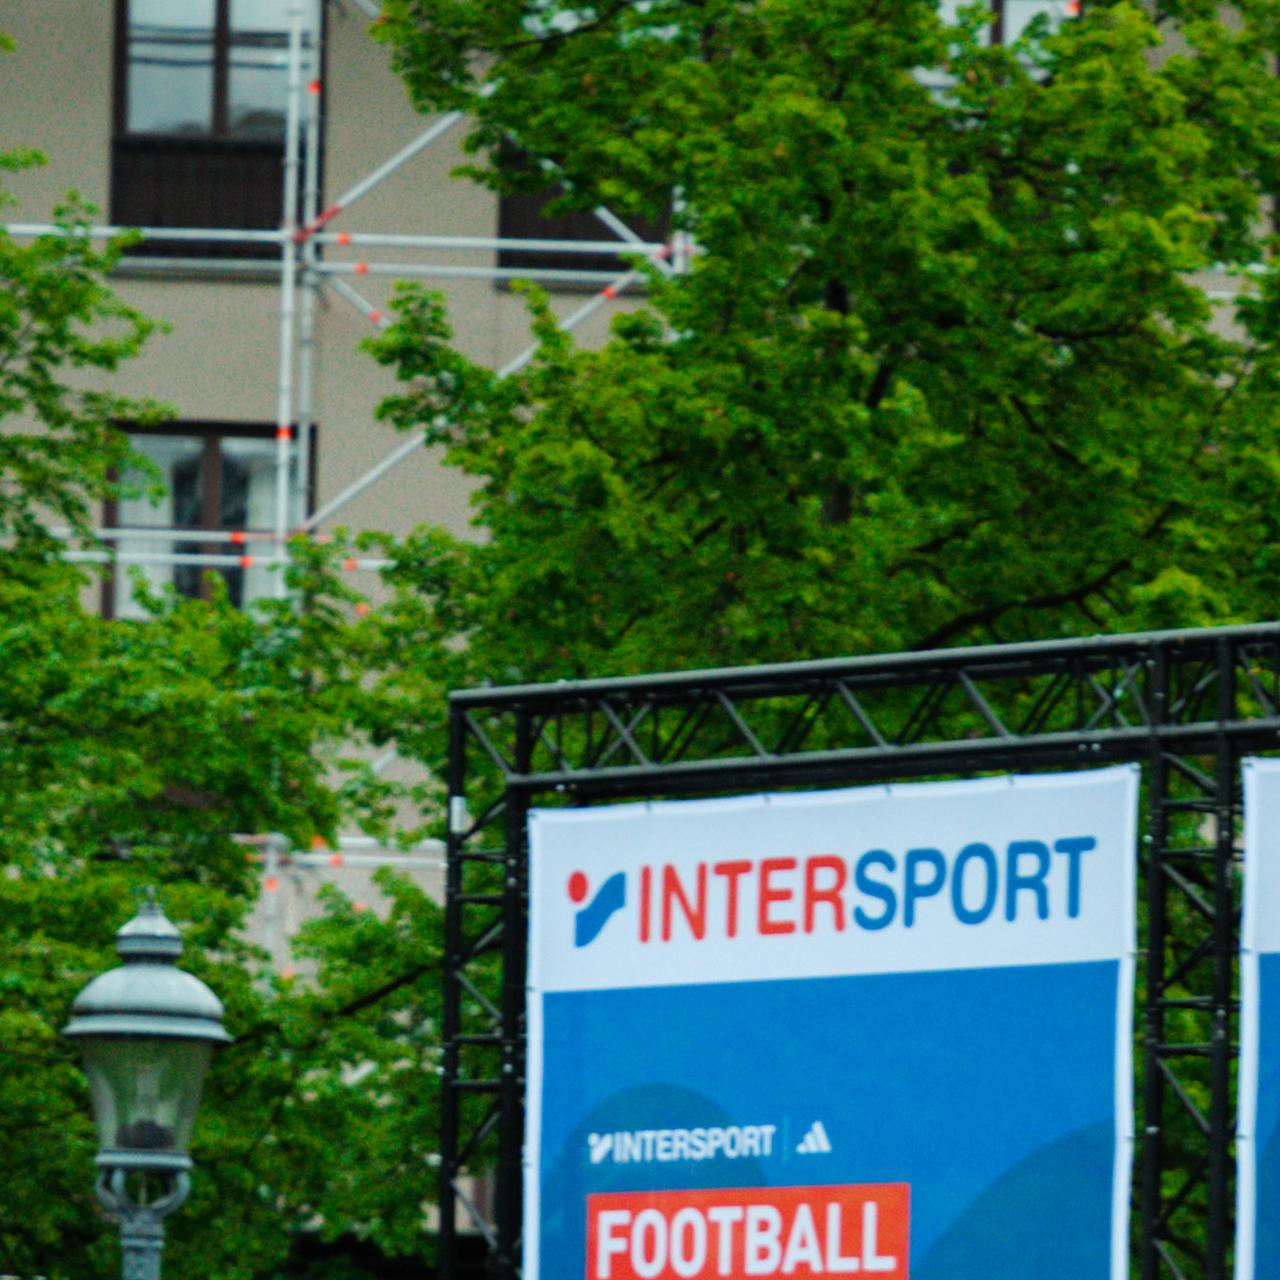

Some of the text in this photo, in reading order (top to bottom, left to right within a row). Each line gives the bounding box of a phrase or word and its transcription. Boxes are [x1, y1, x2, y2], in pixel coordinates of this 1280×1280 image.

[640, 835, 1097, 943] INTERSPORT
[612, 1124, 776, 1164] INTERSPORT
[597, 1201, 897, 1280] FOOTBALL
